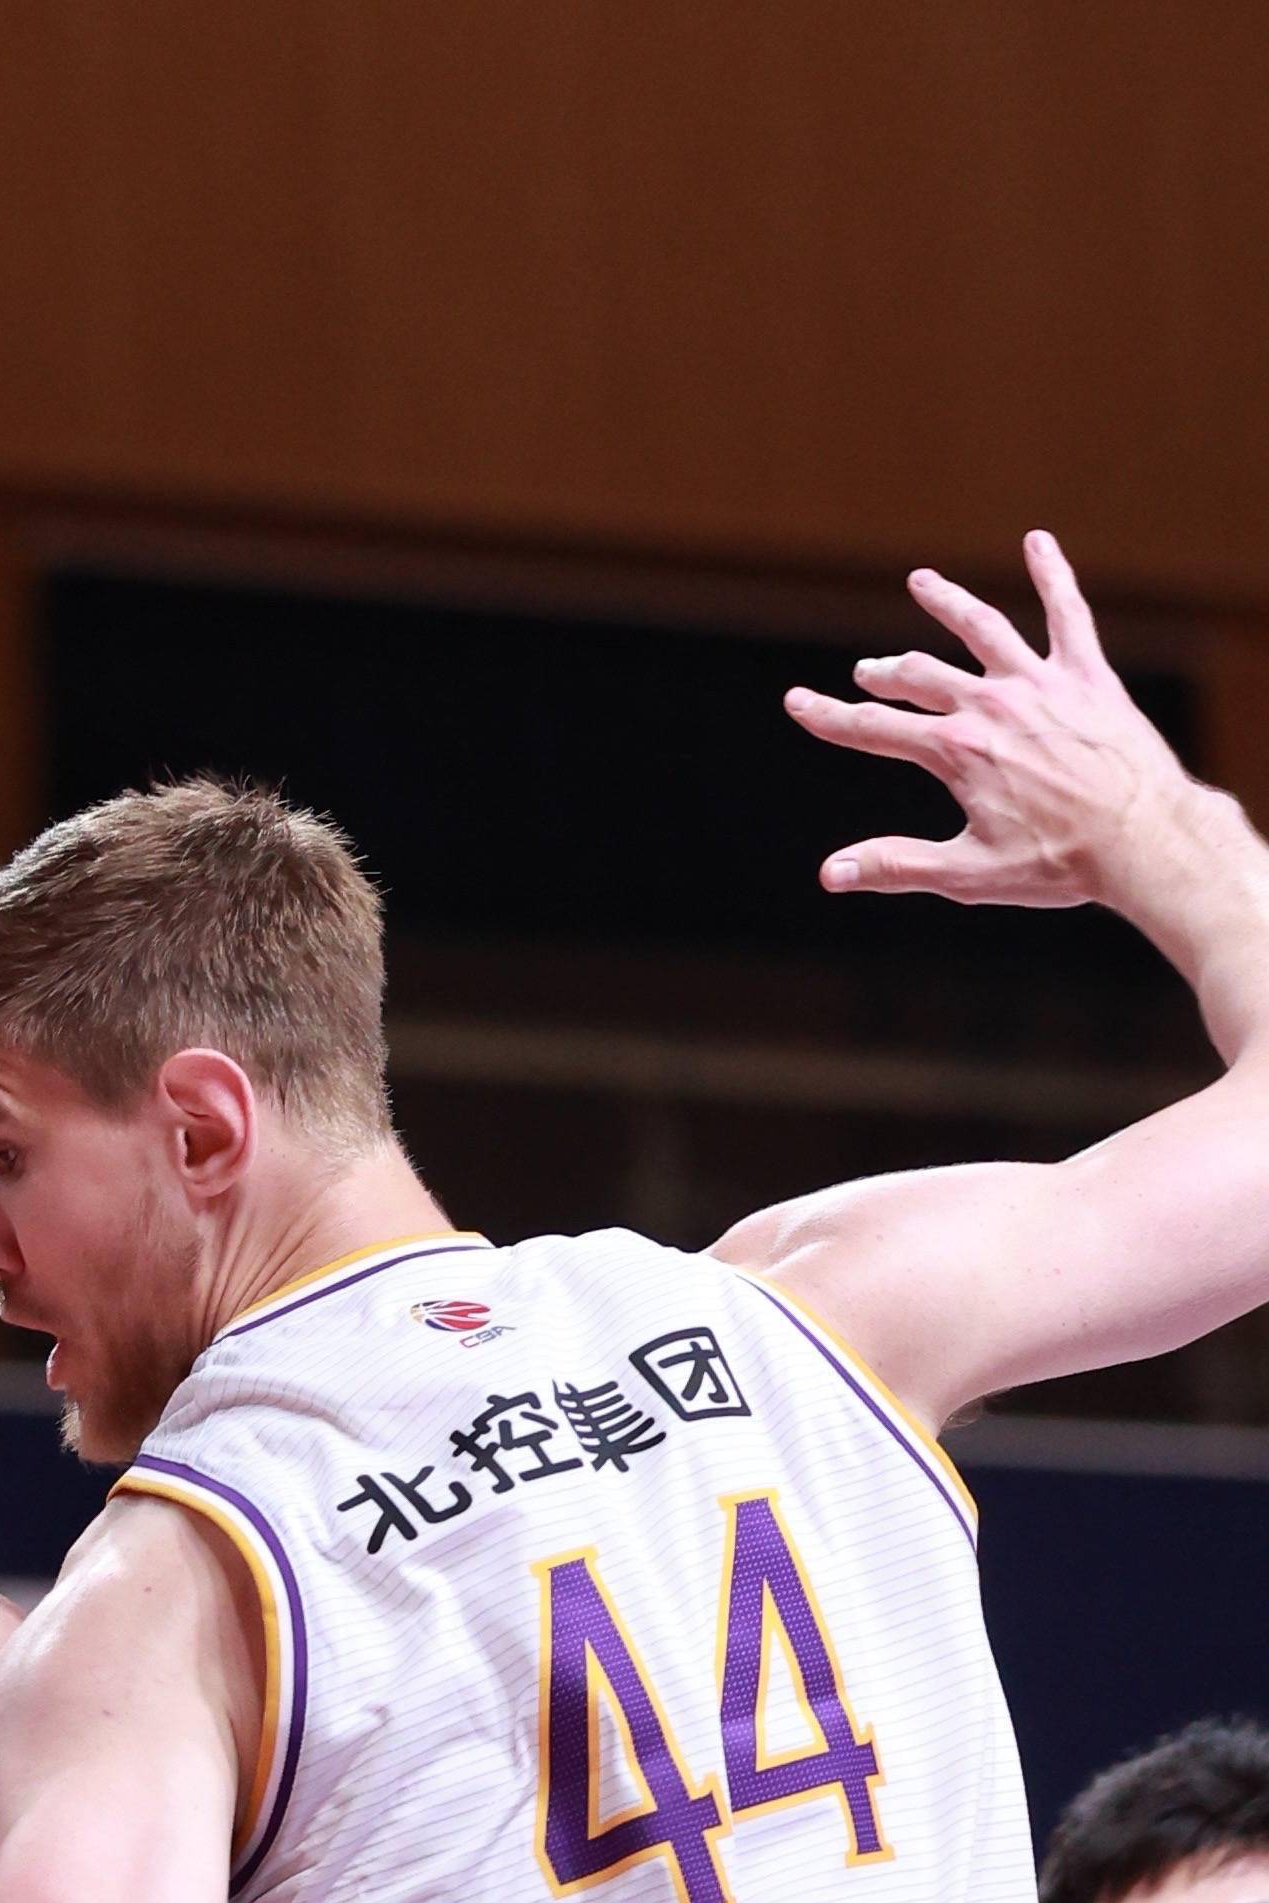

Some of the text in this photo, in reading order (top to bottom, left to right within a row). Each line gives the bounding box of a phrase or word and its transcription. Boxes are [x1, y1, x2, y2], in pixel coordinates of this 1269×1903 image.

[459, 1325, 517, 1349] CBA
[337, 1325, 752, 1555] 北控集团
